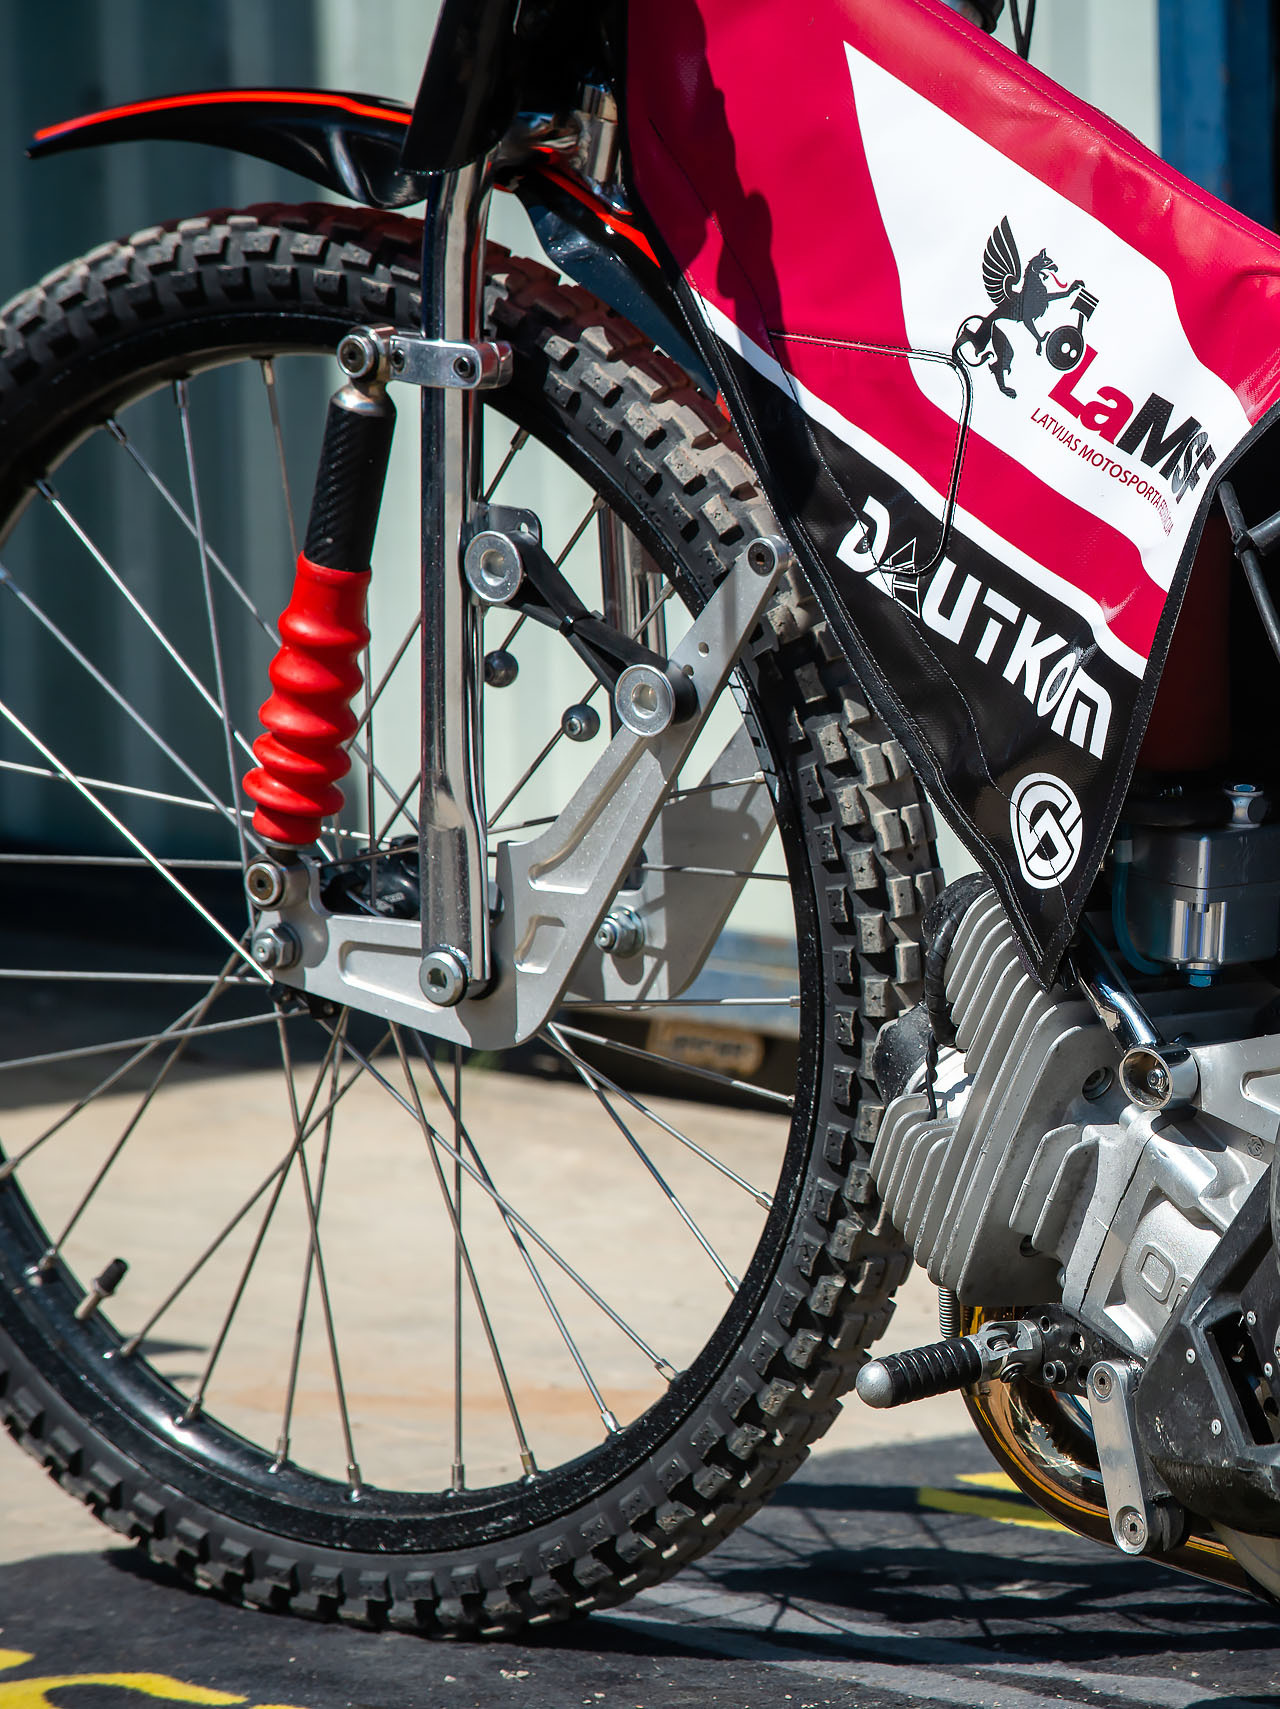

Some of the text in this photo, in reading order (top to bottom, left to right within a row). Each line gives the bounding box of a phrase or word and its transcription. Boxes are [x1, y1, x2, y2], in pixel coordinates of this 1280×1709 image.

[1030, 407, 1081, 451] LATVIJAS
[1077, 444, 1160, 508] MOTOSPORTA
[1048, 343, 1217, 504] LaMSF
